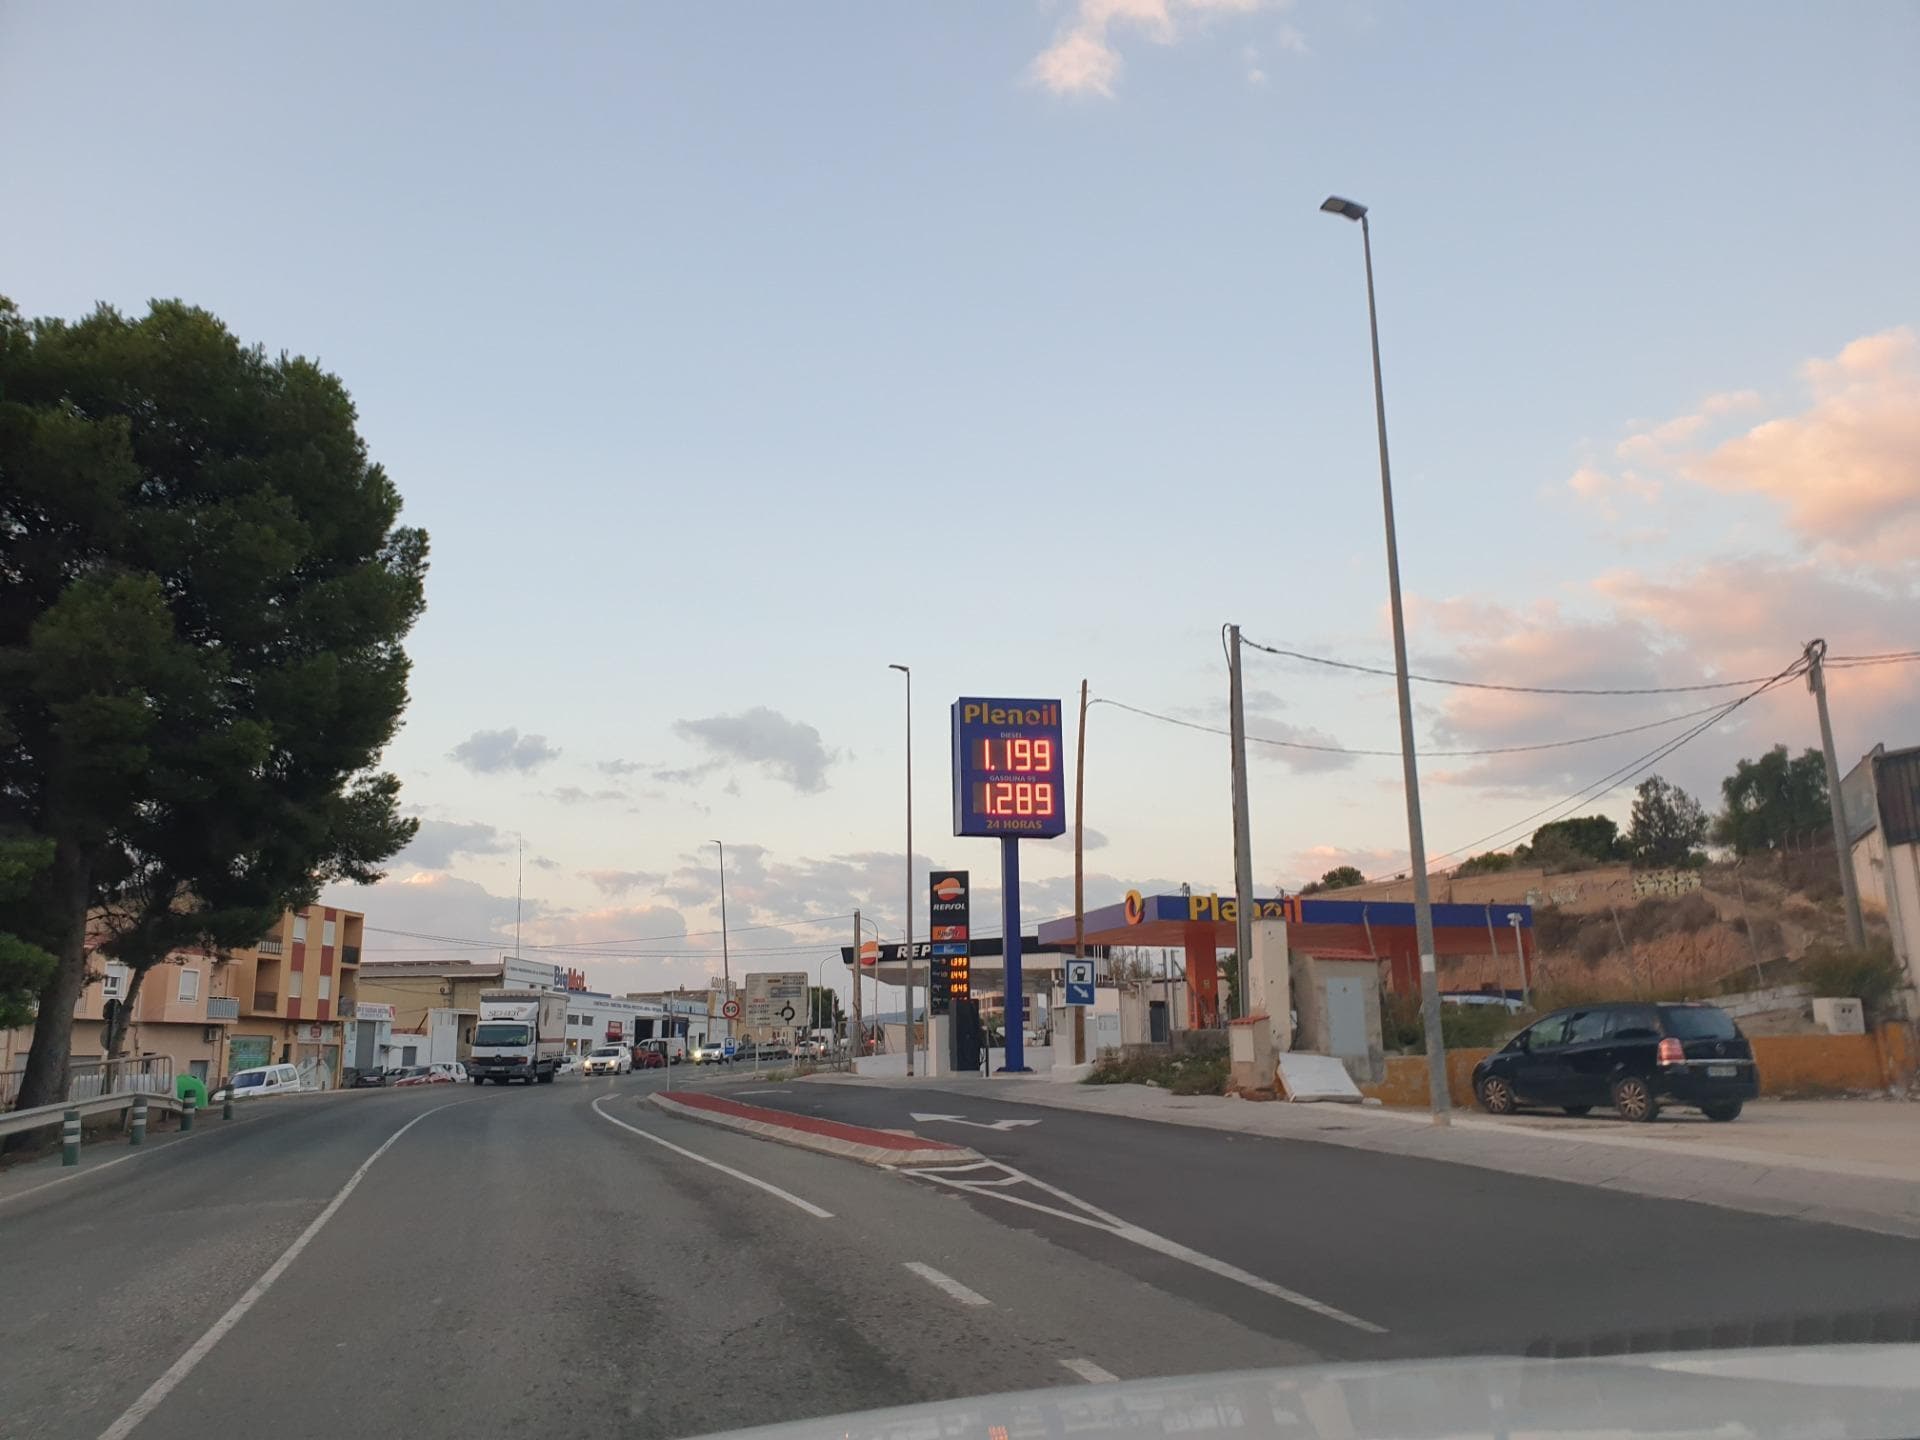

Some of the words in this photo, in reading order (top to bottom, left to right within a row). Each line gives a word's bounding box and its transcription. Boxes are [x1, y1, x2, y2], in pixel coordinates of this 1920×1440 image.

[964, 703, 1057, 726] Plenoil
[984, 739, 1051, 772] 1.199
[985, 783, 1052, 815] 1.289
[986, 820, 999, 829] 24
[1003, 820, 1042, 829] HORAS
[933, 903, 966, 911] REPSOL
